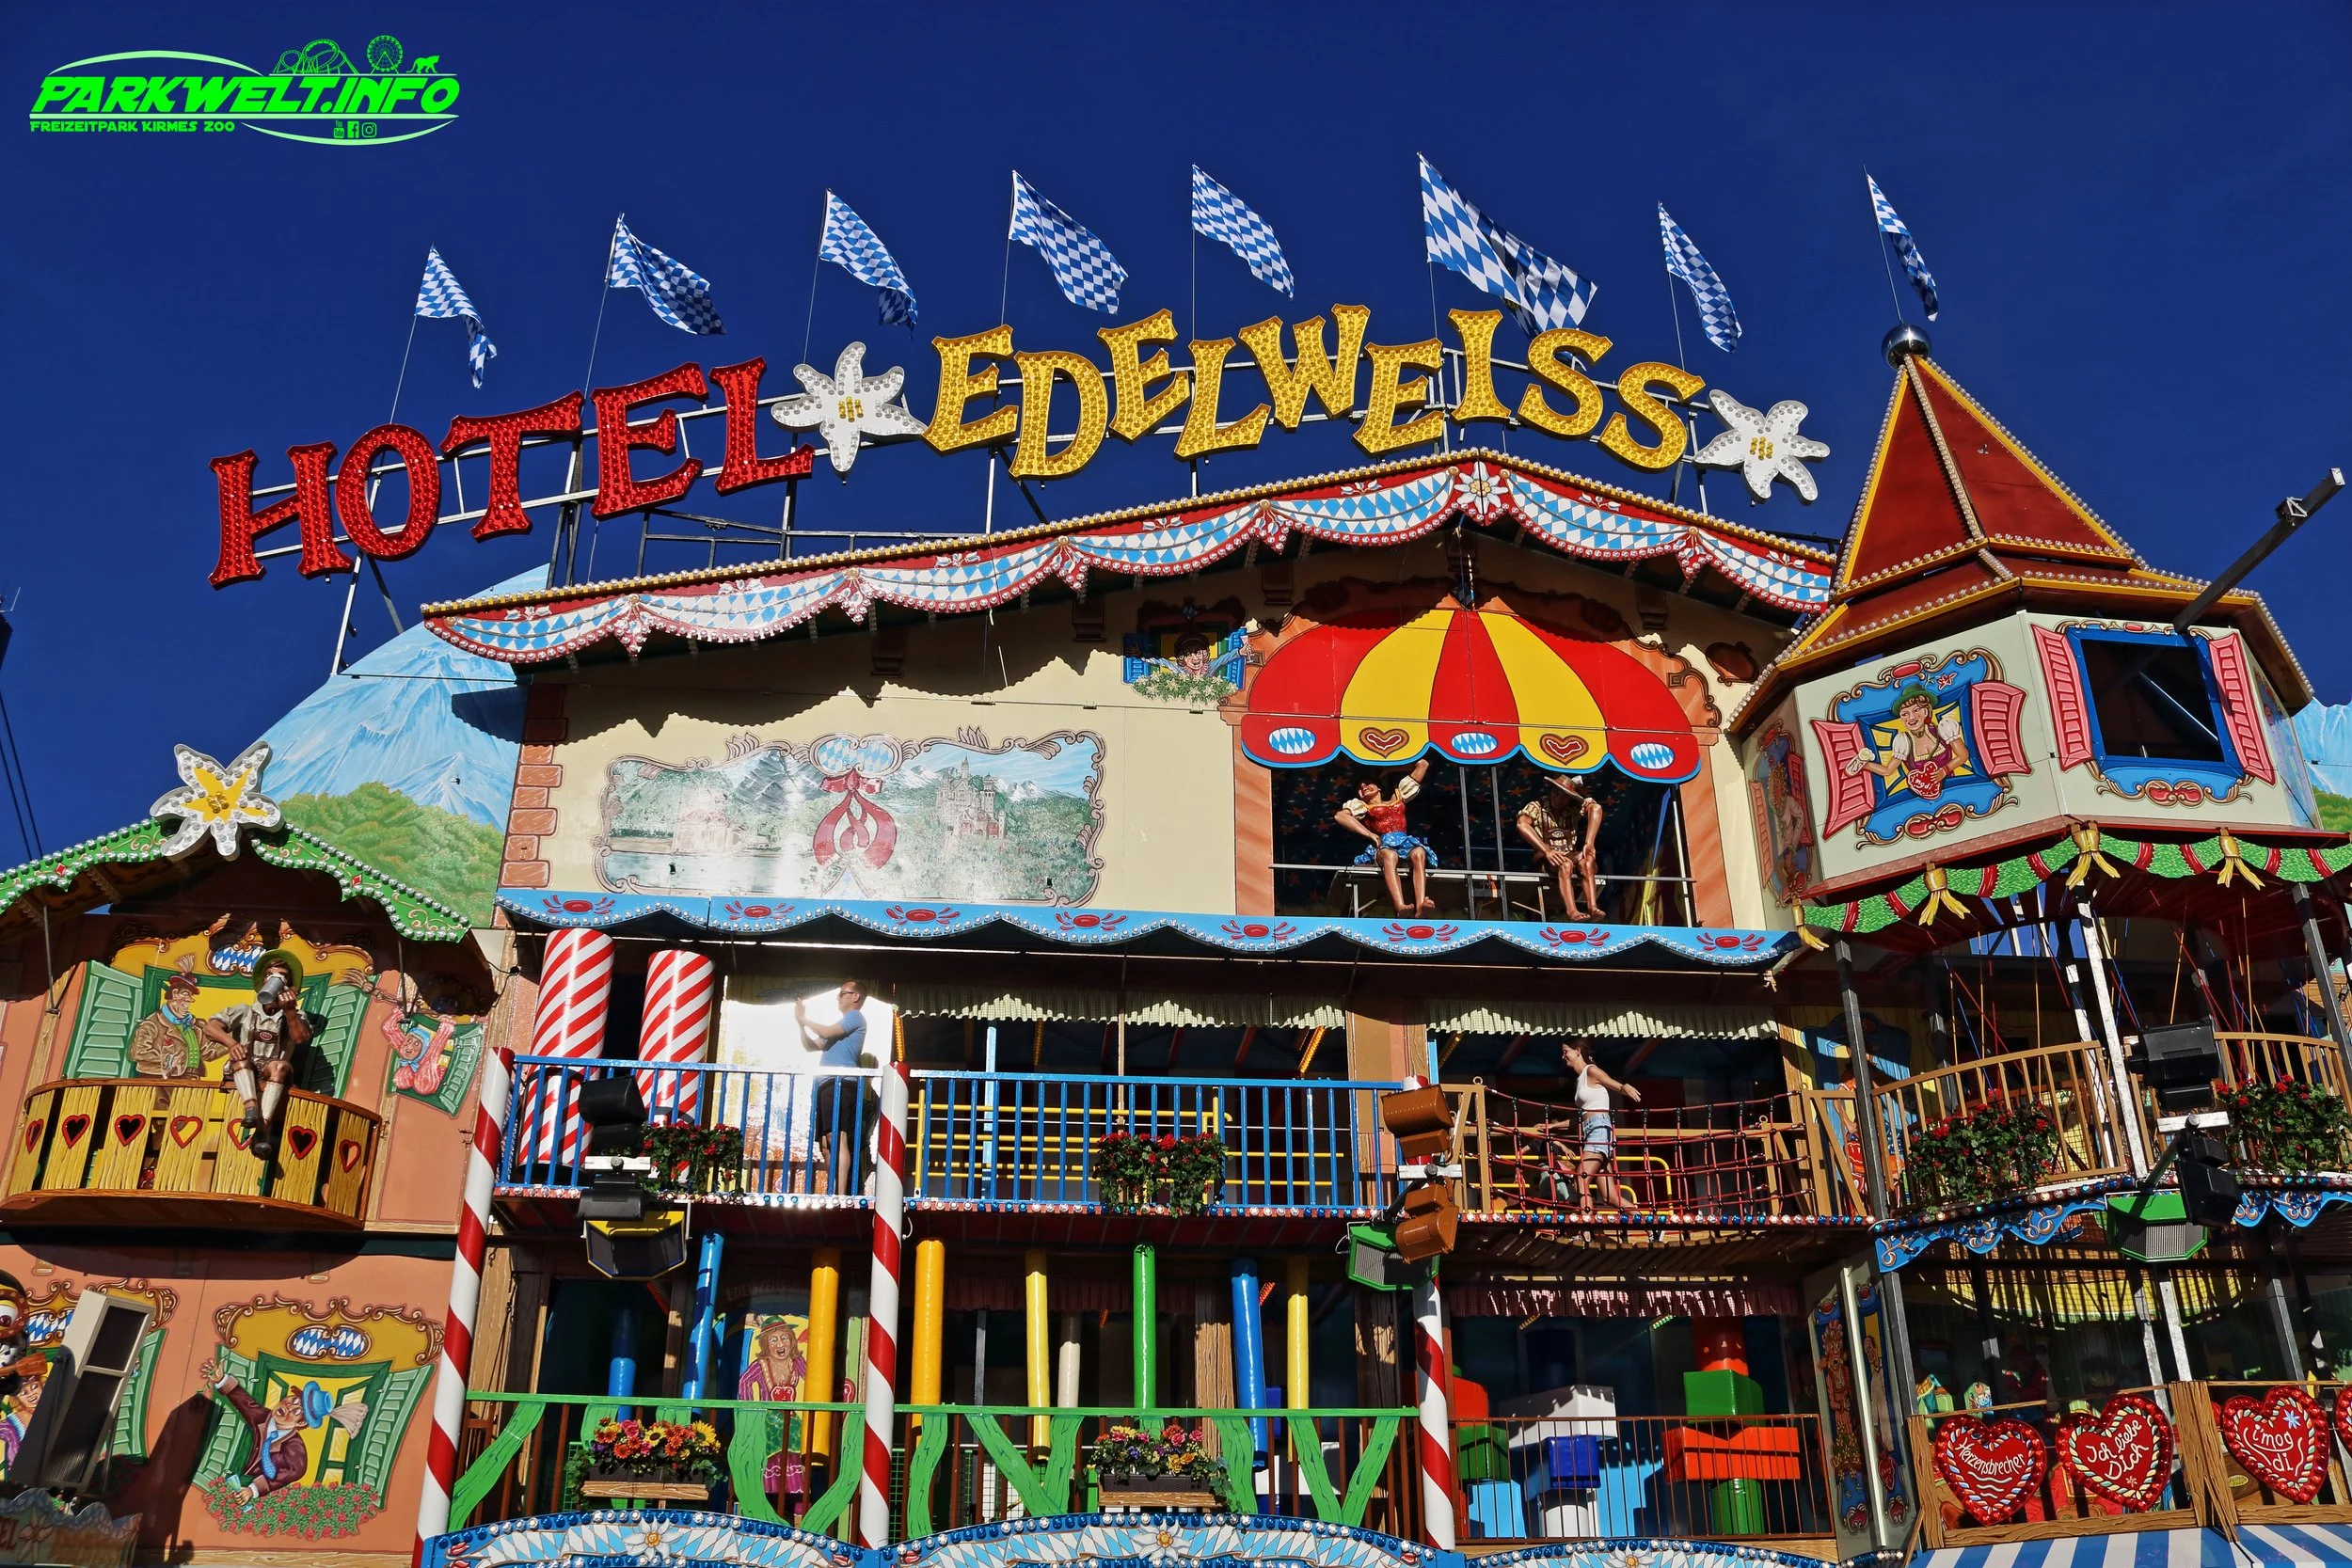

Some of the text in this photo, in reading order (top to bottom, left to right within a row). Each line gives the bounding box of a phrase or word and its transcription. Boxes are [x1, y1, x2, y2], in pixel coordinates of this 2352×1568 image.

[208, 304, 1706, 590] HOTEL EDELWEISS
[2115, 1420, 2142, 1453] liebe
[1955, 1437, 2026, 1475] Herzensbrecher
[2105, 1443, 2149, 1480] Dich
[2273, 1452, 2294, 1471] di
